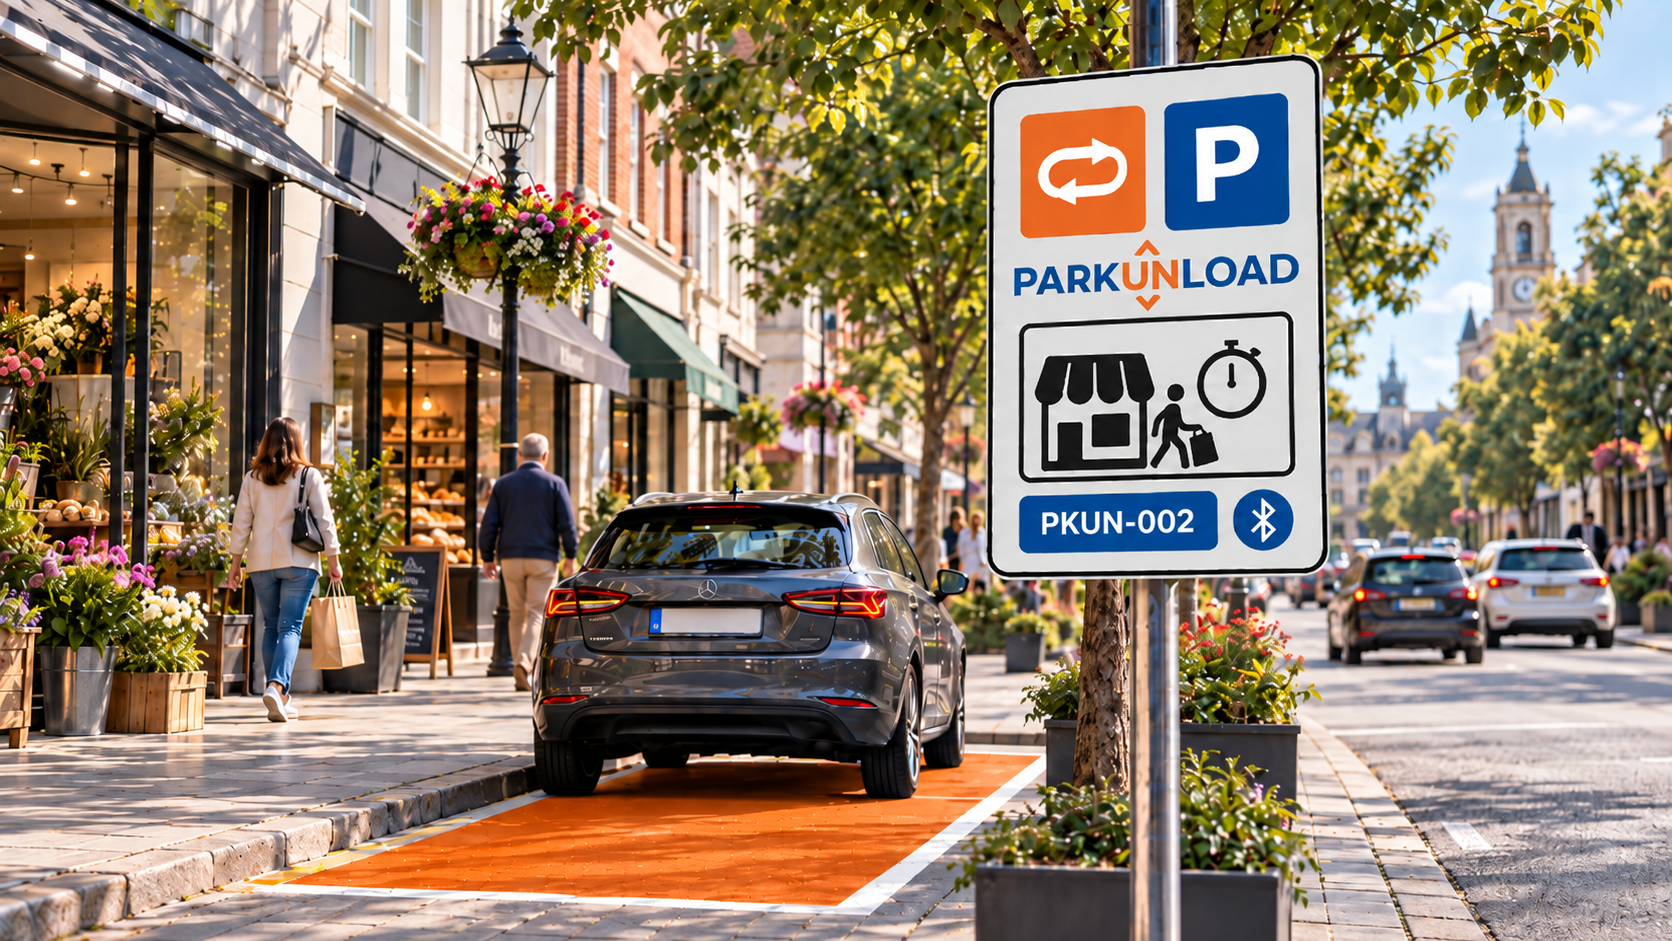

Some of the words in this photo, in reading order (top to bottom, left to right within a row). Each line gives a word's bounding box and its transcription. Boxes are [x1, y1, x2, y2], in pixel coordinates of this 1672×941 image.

[1195, 124, 1260, 203] P
[1013, 253, 1299, 296] PARKUNLOAD
[1041, 508, 1194, 535] PKUN-002
